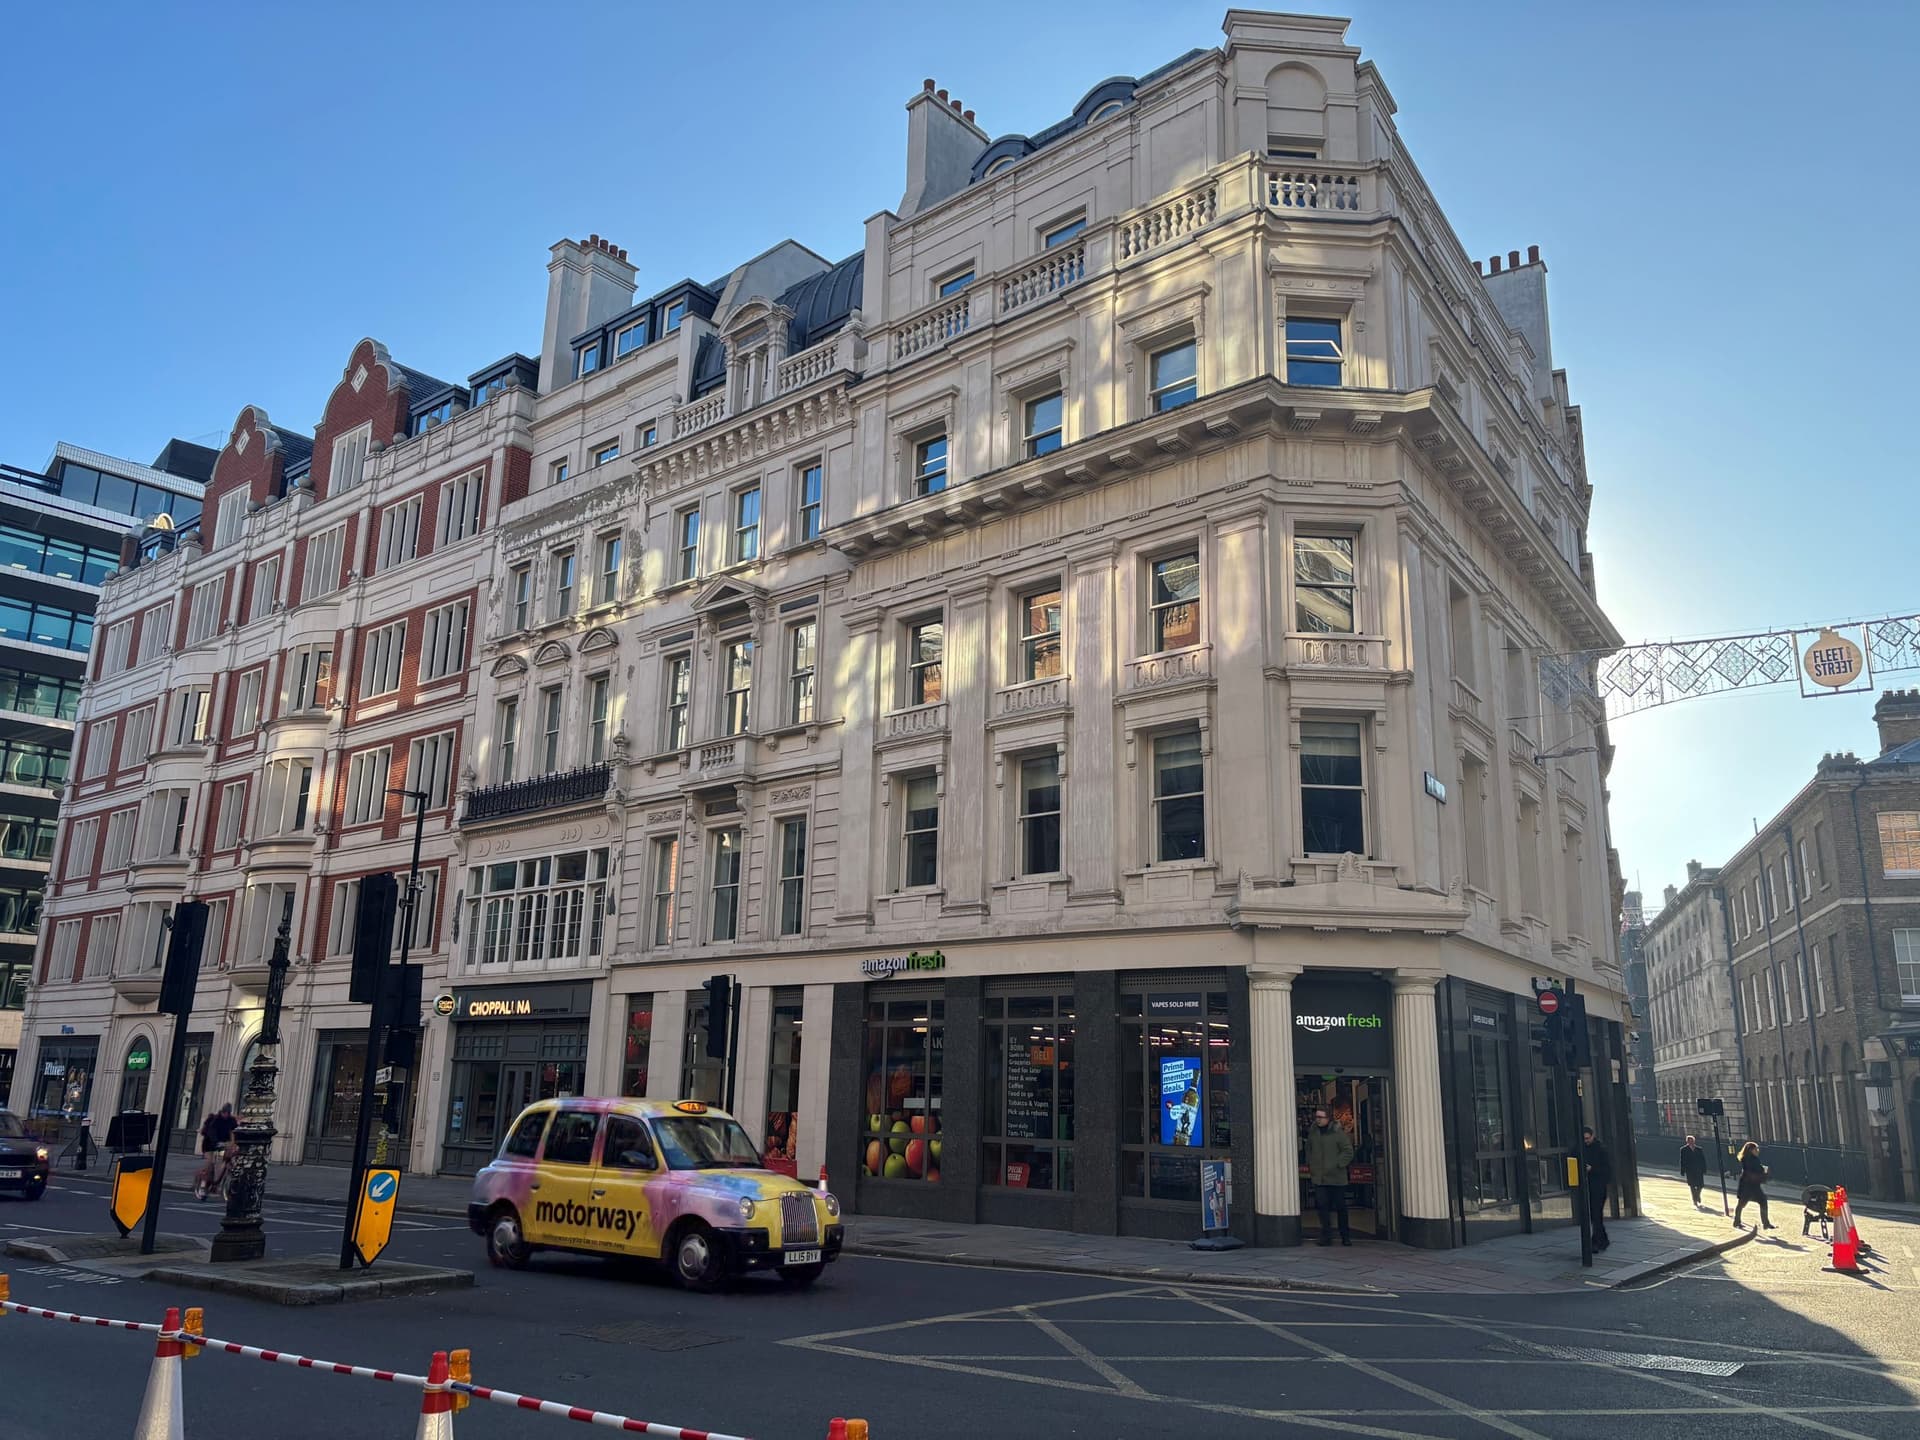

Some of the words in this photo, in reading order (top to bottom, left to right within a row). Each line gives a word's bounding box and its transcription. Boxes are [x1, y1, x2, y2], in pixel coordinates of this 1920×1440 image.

[1813, 647, 1844, 664] FLEET
[1163, 1062, 1184, 1072] Prime
[1163, 1072, 1193, 1082] member
[1163, 1083, 1183, 1093] deals.
[687, 1102, 706, 1111] TAXI
[535, 1199, 642, 1240] motorway
[788, 1252, 805, 1263] LL15
[806, 1251, 819, 1262] BYV
